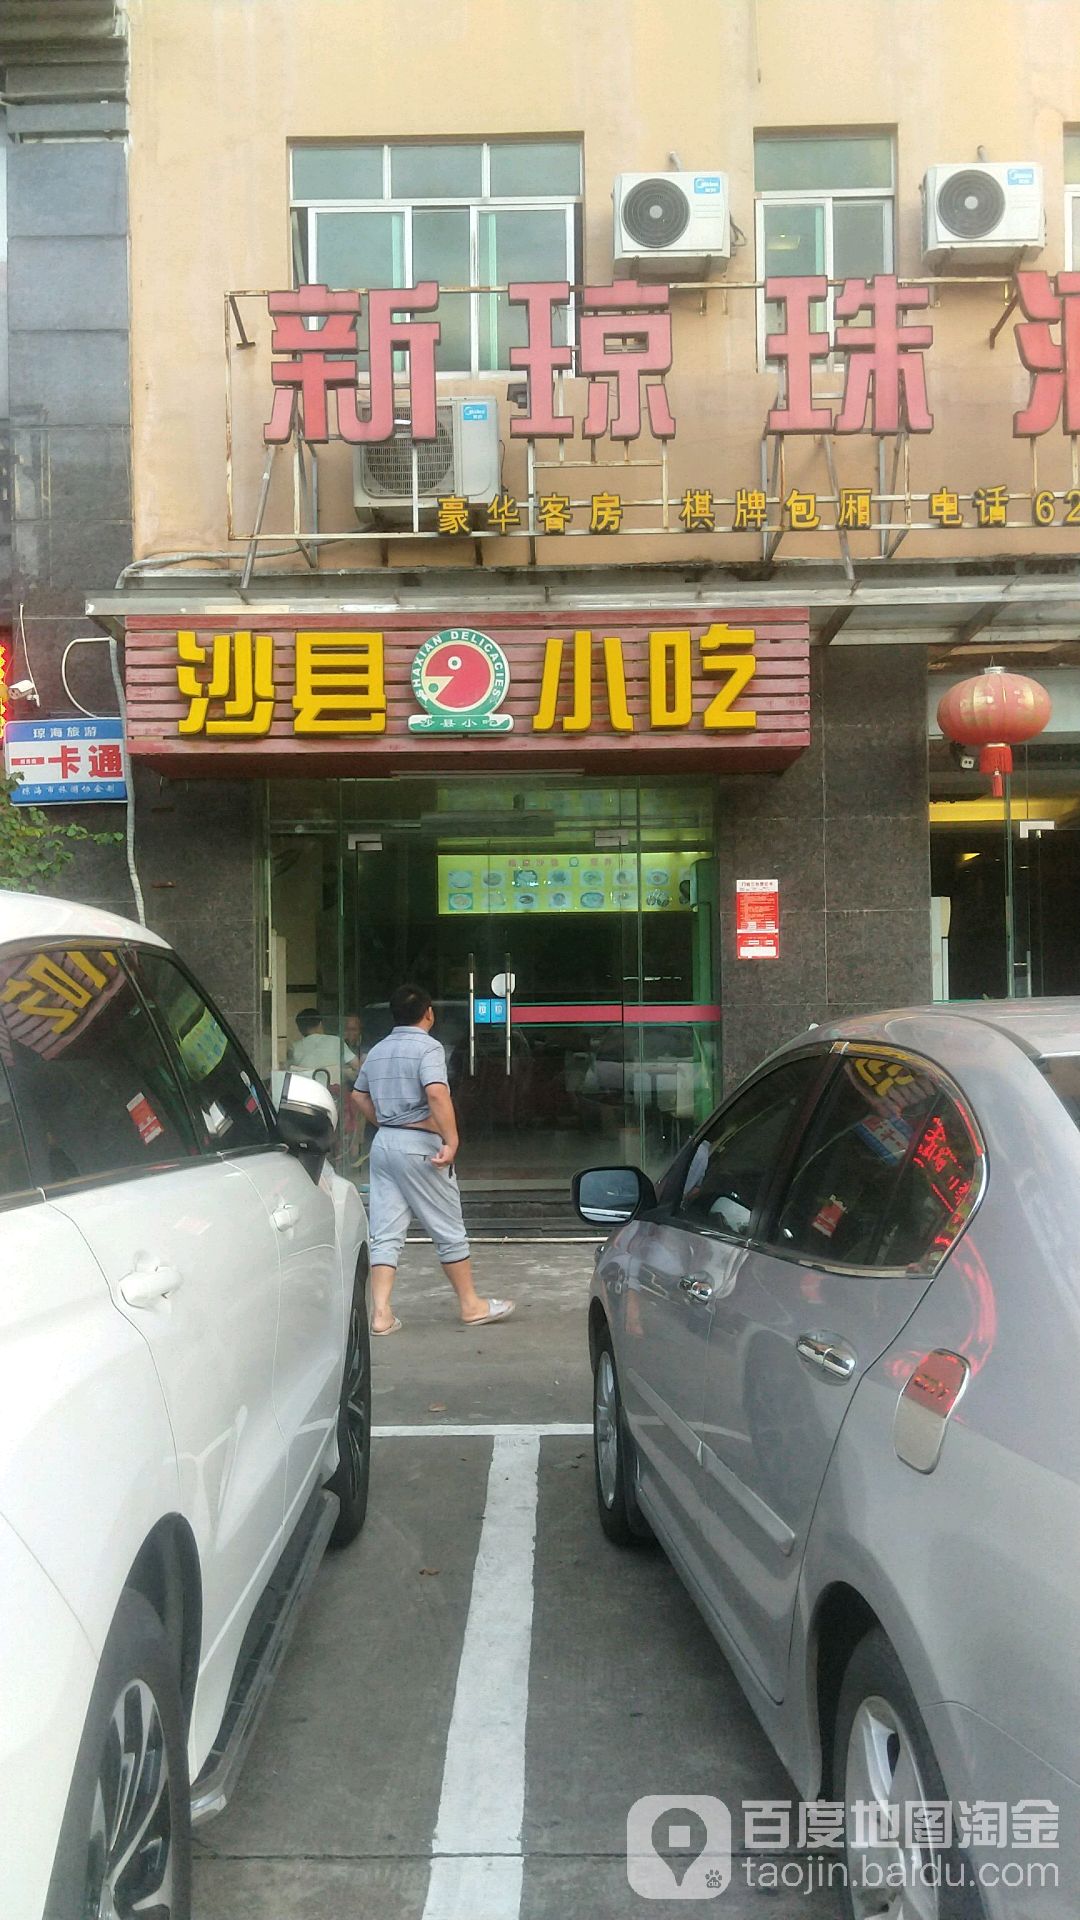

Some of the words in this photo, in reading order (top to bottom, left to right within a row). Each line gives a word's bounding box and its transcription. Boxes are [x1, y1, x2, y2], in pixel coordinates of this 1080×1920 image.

[438, 493, 622, 534] 豪华客房
[681, 488, 872, 529] 棋牌包厢
[929, 485, 1008, 527] 电话
[174, 629, 387, 736] 沙县
[532, 622, 758, 733] 小吃
[412, 635, 443, 699] SHAXIAN
[450, 631, 504, 697] DELICACIES
[32, 726, 97, 739] 琼海旅游
[11, 744, 123, 779] 一卡通
